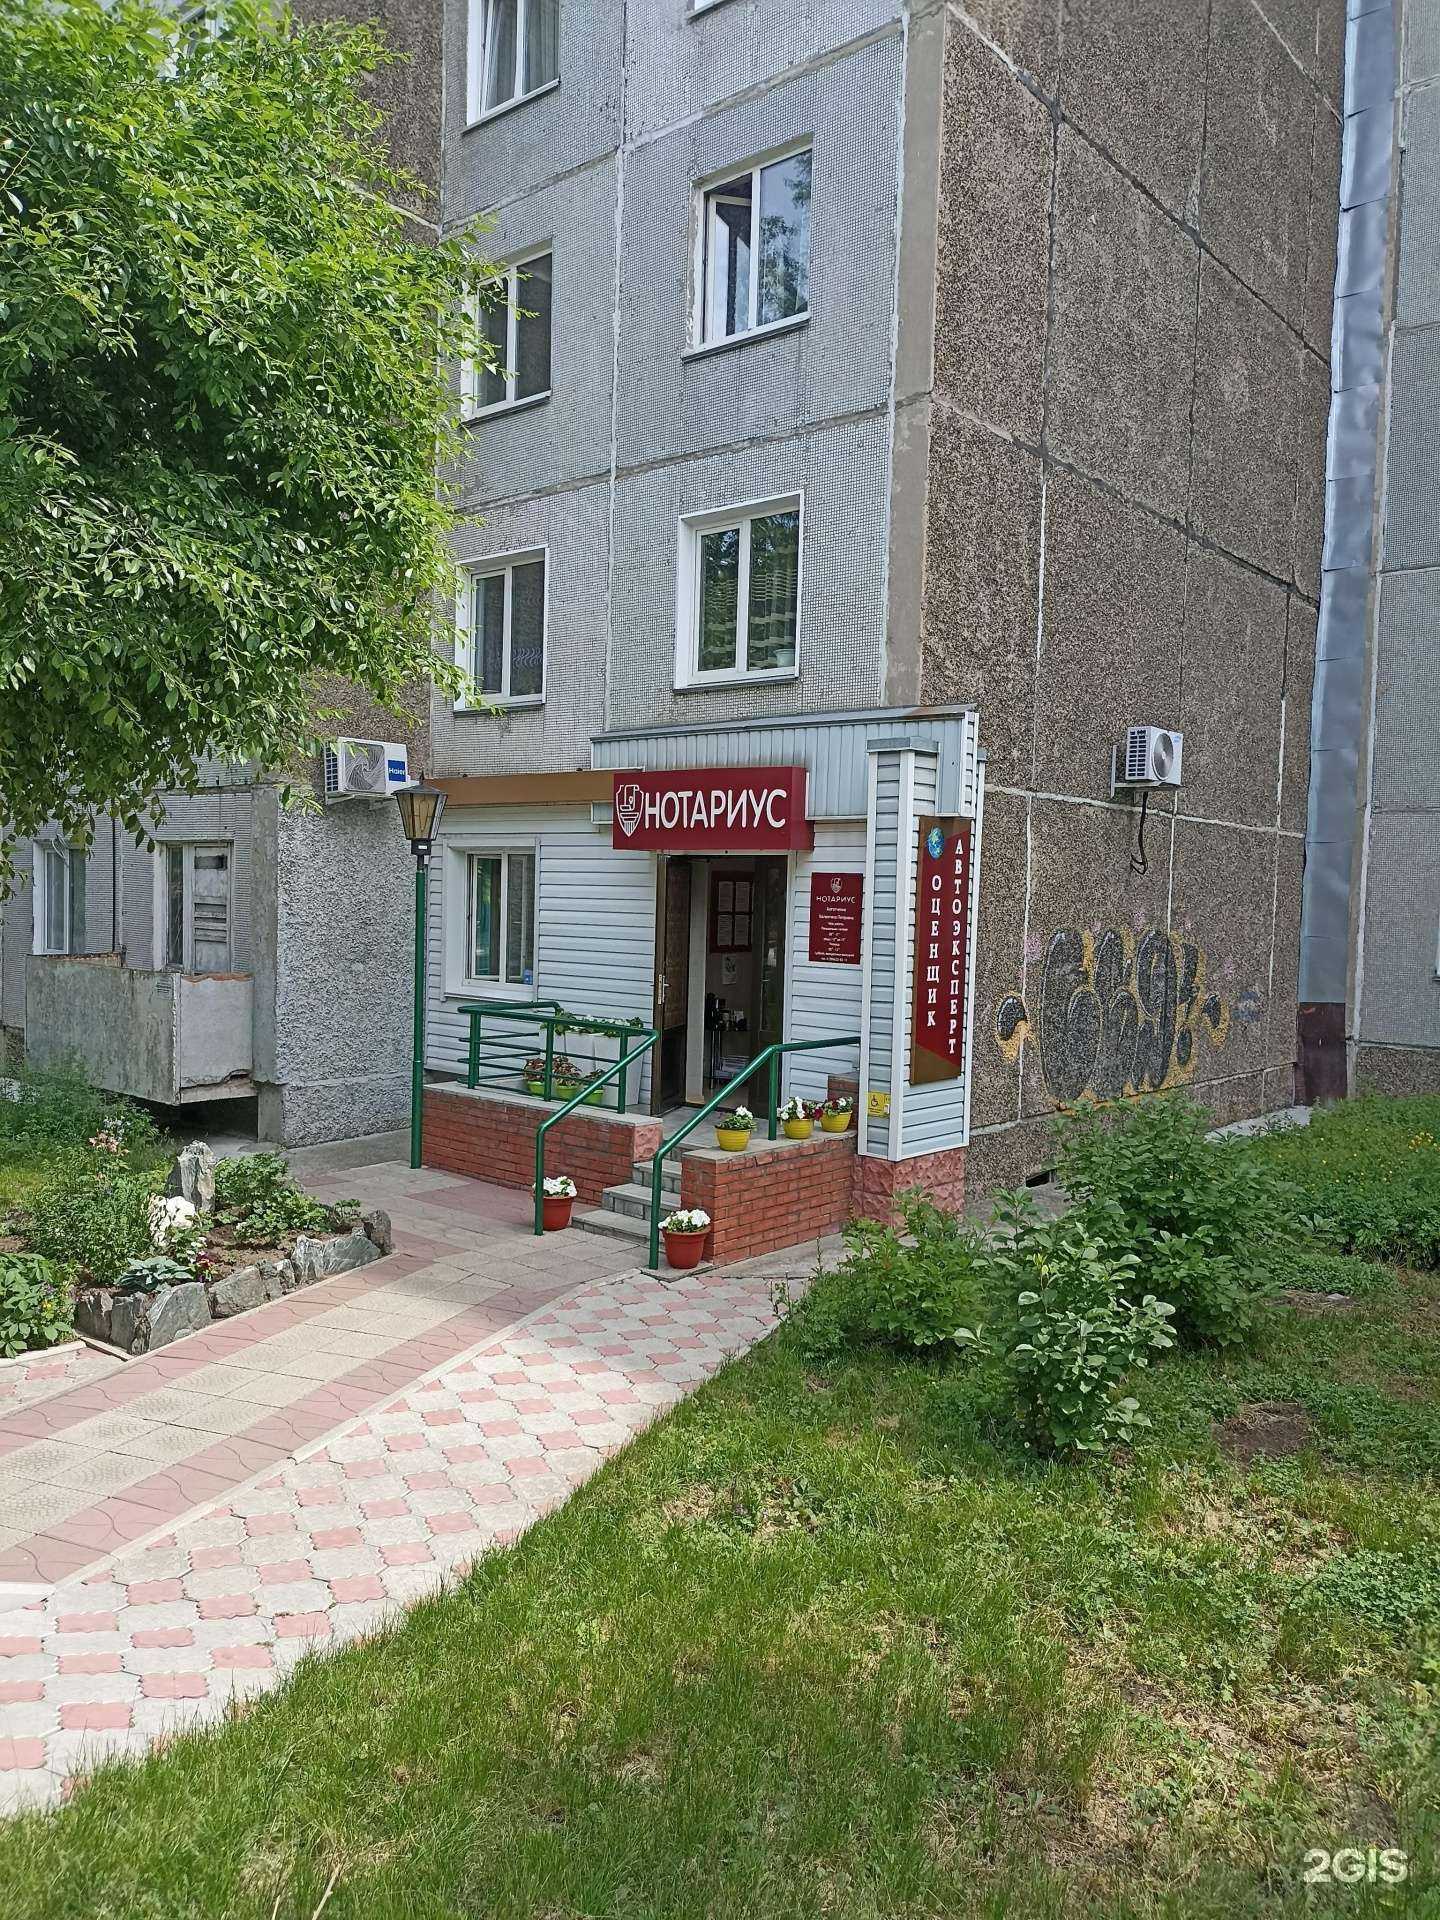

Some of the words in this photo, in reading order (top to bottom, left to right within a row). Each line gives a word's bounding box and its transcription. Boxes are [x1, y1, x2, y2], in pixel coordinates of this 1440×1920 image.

[388, 767, 405, 775] Haier
[645, 789, 787, 829] НОТАРИУС
[816, 896, 856, 904] НОТАРИУС
[926, 874, 942, 1027] ОЦЕНЩИК
[949, 839, 964, 1055] АВТОЭКСПЕРТ
